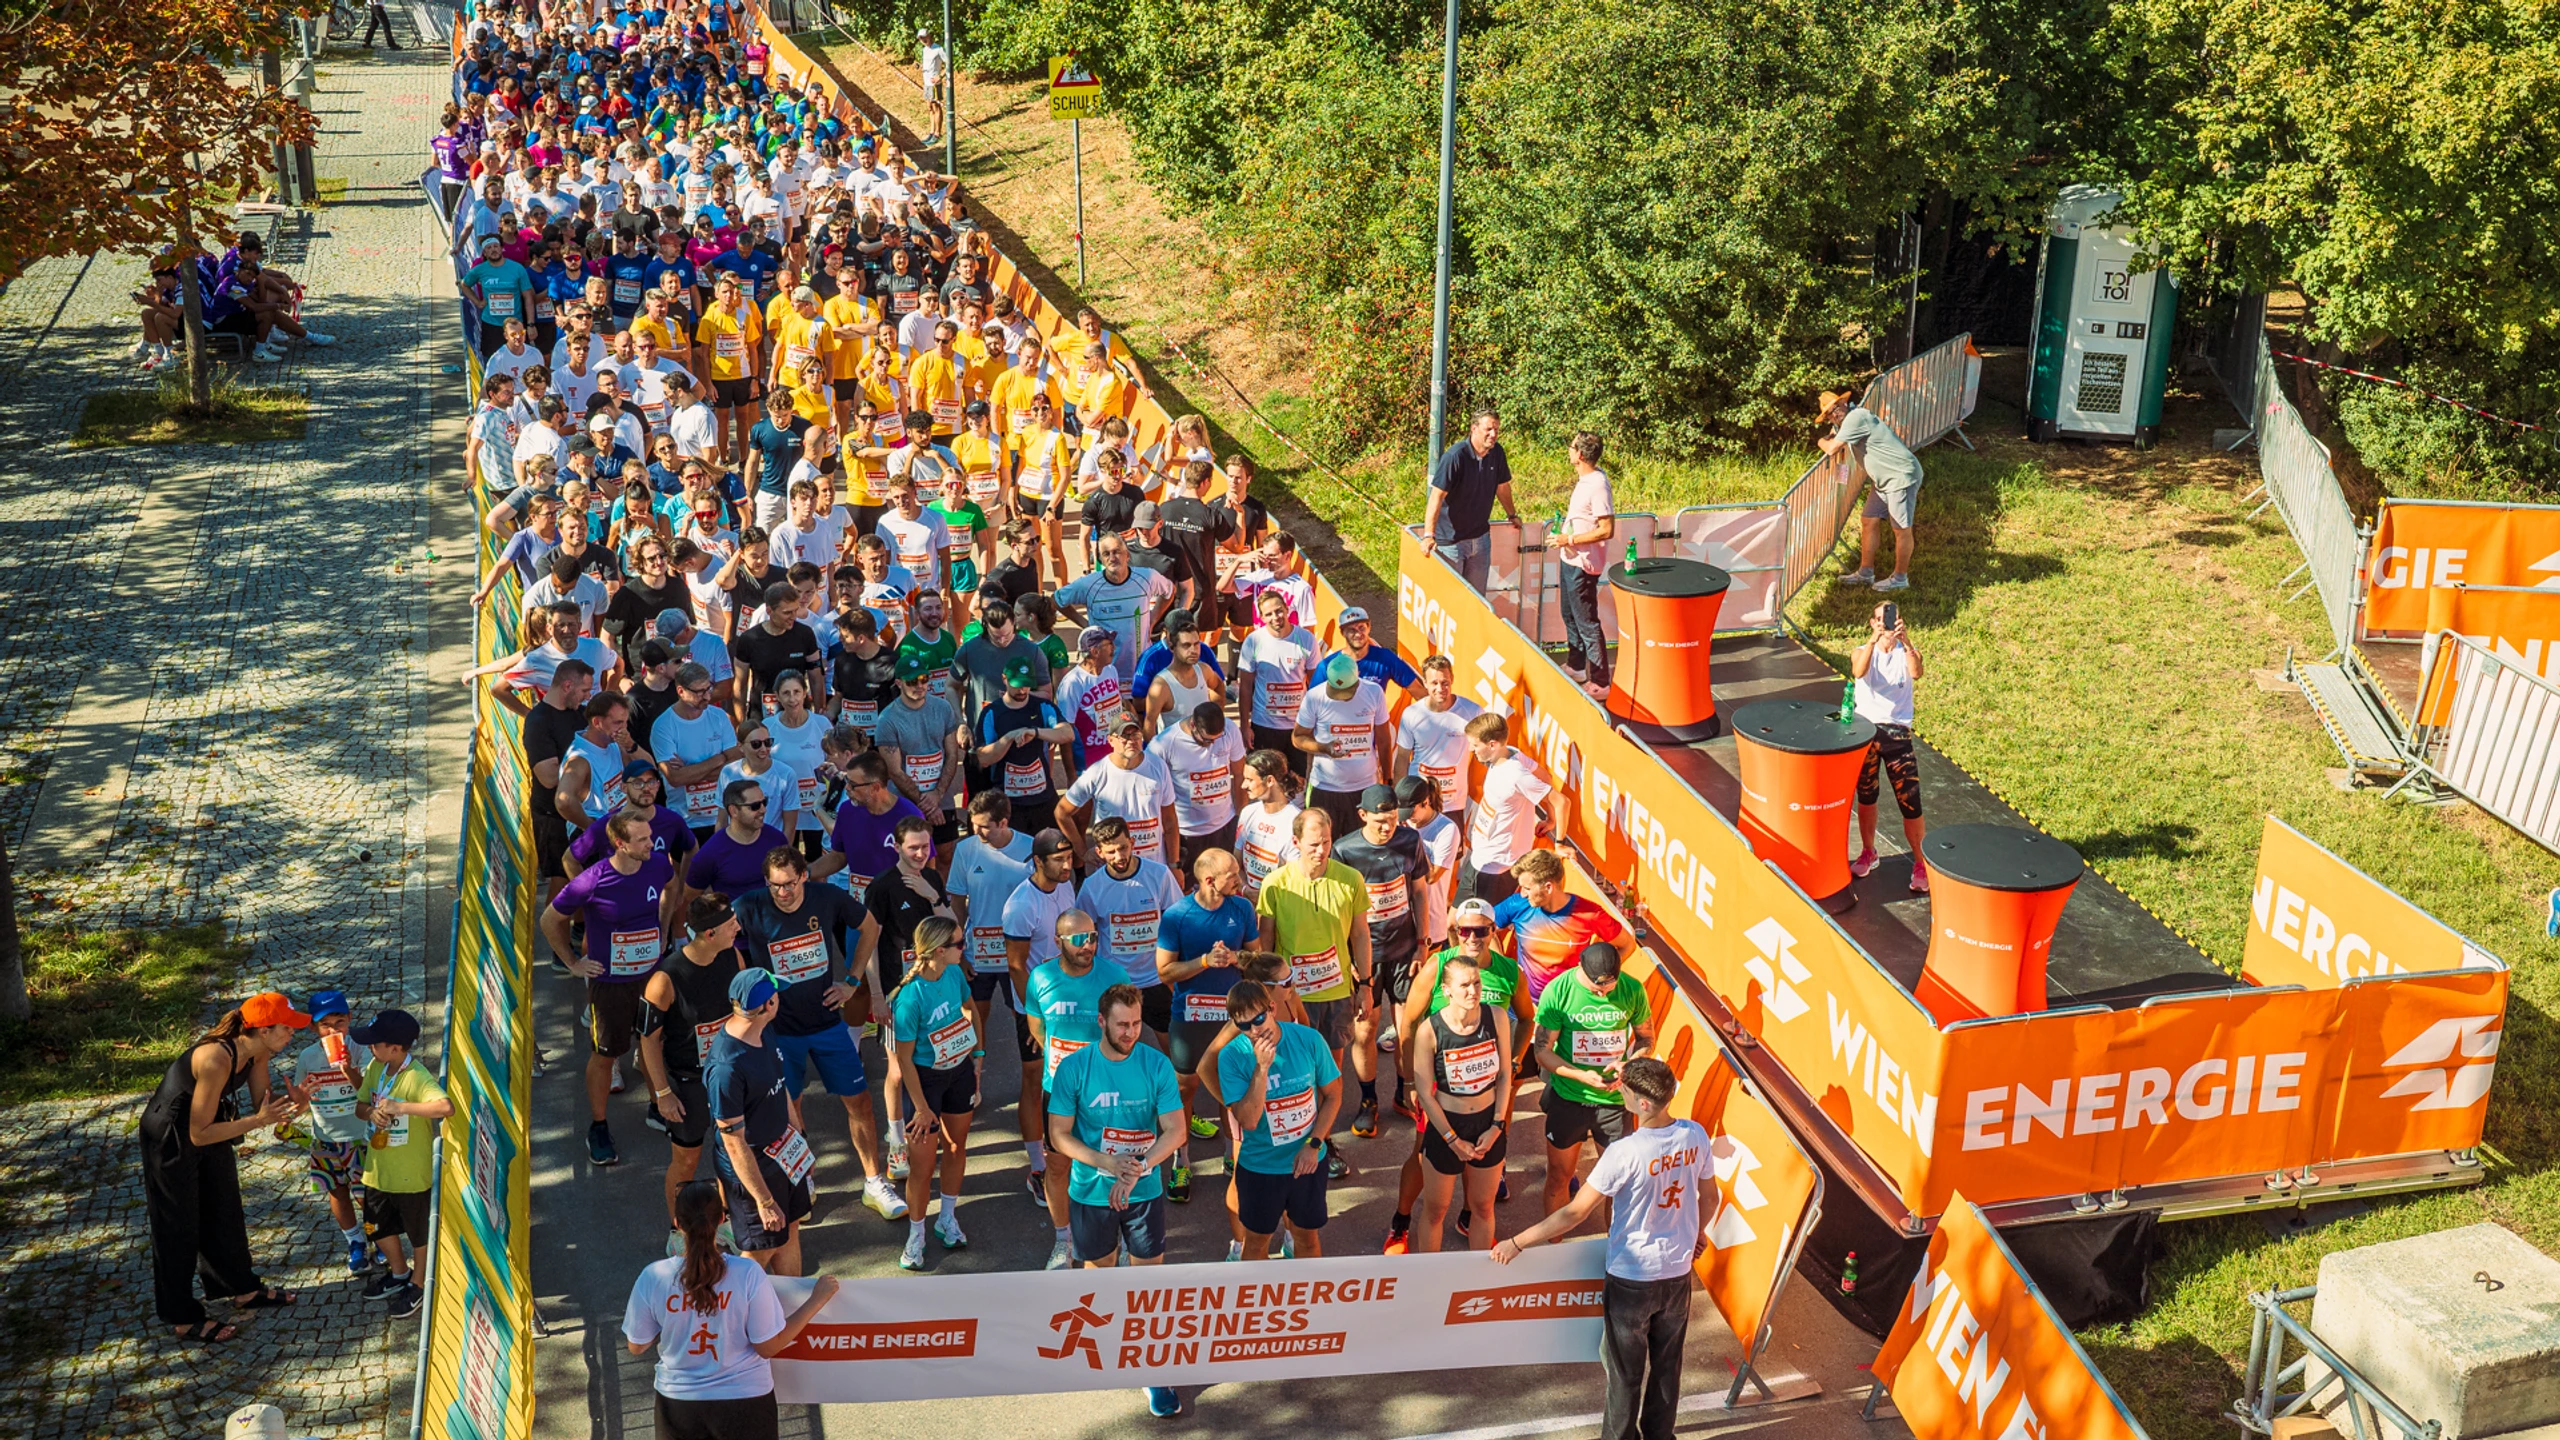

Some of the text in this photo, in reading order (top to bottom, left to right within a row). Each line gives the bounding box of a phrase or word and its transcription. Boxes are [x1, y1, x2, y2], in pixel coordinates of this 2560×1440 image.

[2104, 271, 2130, 285] TOI
[2103, 287, 2129, 301] TOI
[1081, 679, 1118, 707] OFFEN
[1524, 693, 1587, 806] WIEN
[1592, 766, 1716, 930] ENERGIE
[634, 946, 652, 957] 90C
[1957, 934, 2013, 951] WIEN ENERGIE
[791, 948, 822, 964] 2659C
[927, 1001, 949, 1025] AIT
[1044, 1001, 1078, 1015] AIT
[1204, 1012, 1229, 1021] 6731
[1569, 1010, 1627, 1024] VORWERK
[1592, 1035, 1622, 1048] 8365A
[1465, 1059, 1496, 1075] 6685A
[1827, 990, 1939, 1158] WIEN
[1088, 1091, 1120, 1108] AIT
[1962, 1052, 2308, 1150] ENERGIE
[1649, 1146, 1699, 1177] CREW
[666, 1290, 732, 1313] CRW
[1126, 1277, 1398, 1314] WIEN ENERGIE
[1501, 1294, 1550, 1310] WIEN
[1121, 1308, 1309, 1341] BUSINESS
[807, 1330, 966, 1351] WIEN ENERGIE
[1118, 1336, 1343, 1369] RUN DONAUINSEL
